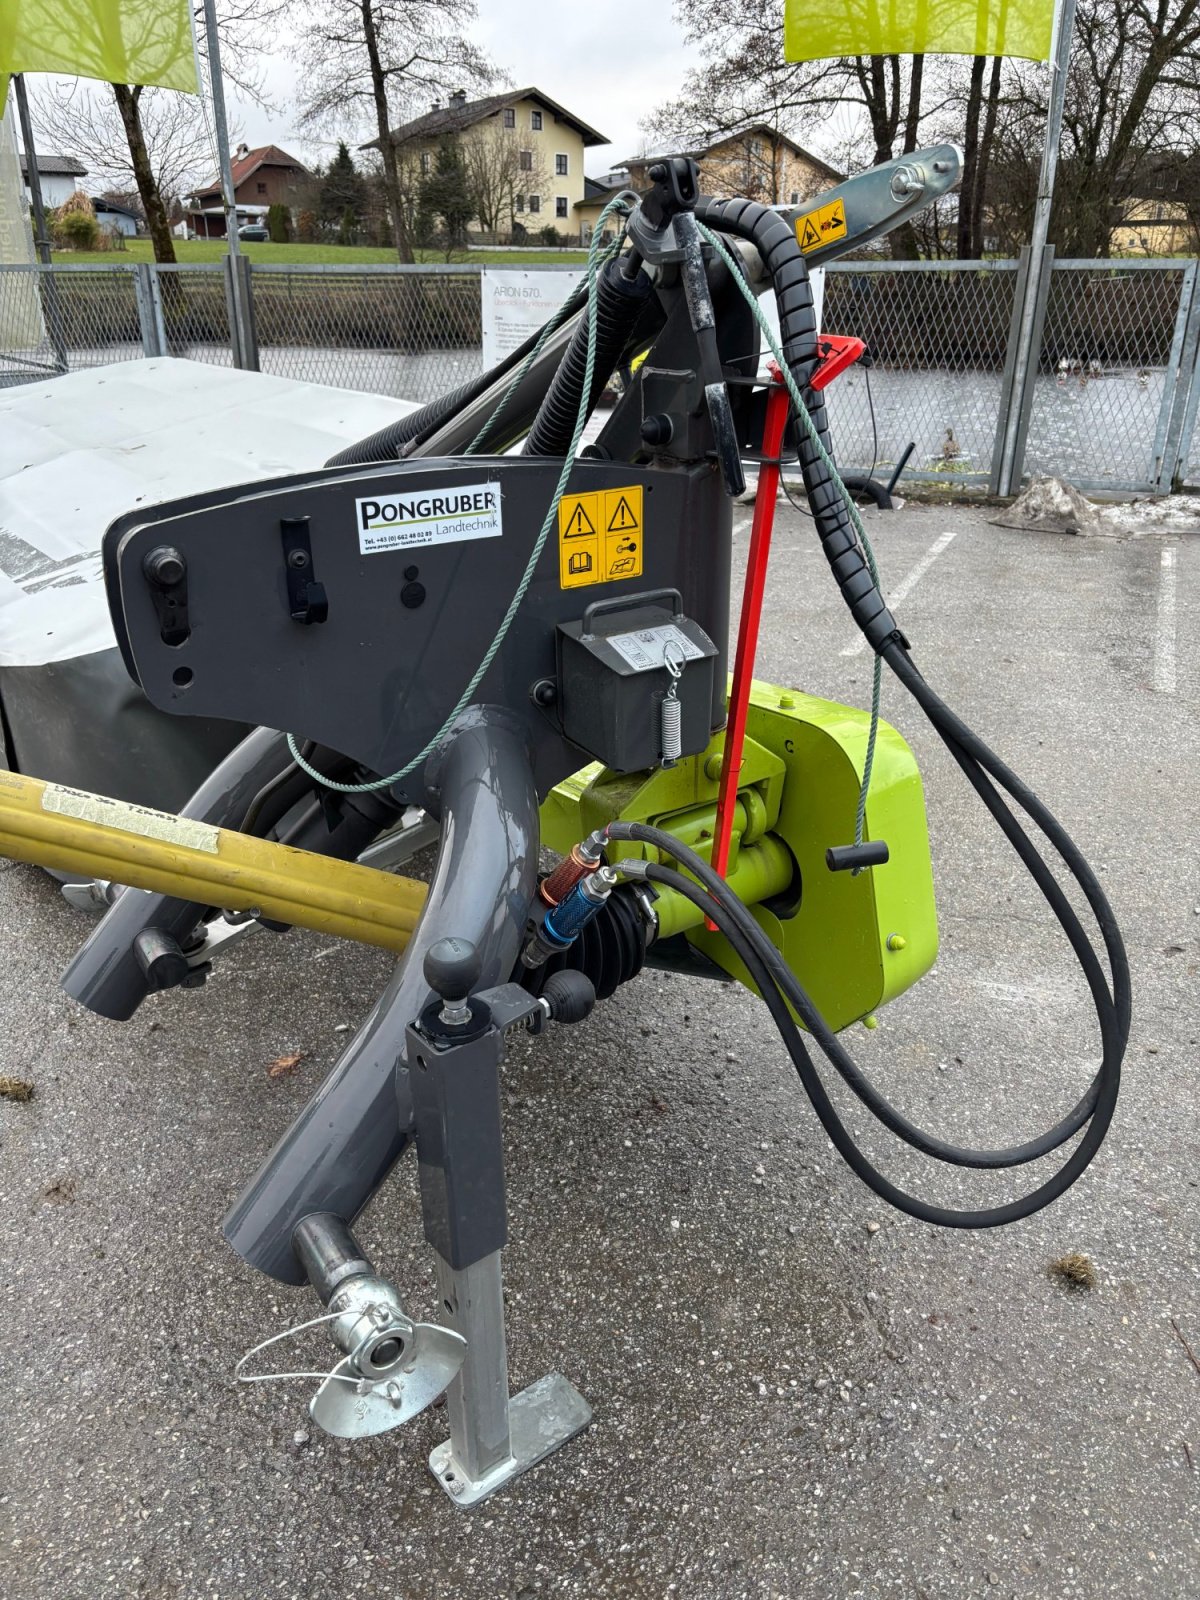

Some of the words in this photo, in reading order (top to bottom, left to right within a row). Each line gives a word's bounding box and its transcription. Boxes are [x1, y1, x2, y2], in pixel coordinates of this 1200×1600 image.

[493, 287, 520, 297] ARION
[522, 288, 542, 298] 570.
[361, 492, 497, 530] PONGRUBER
[436, 518, 498, 535] Landtechnik
